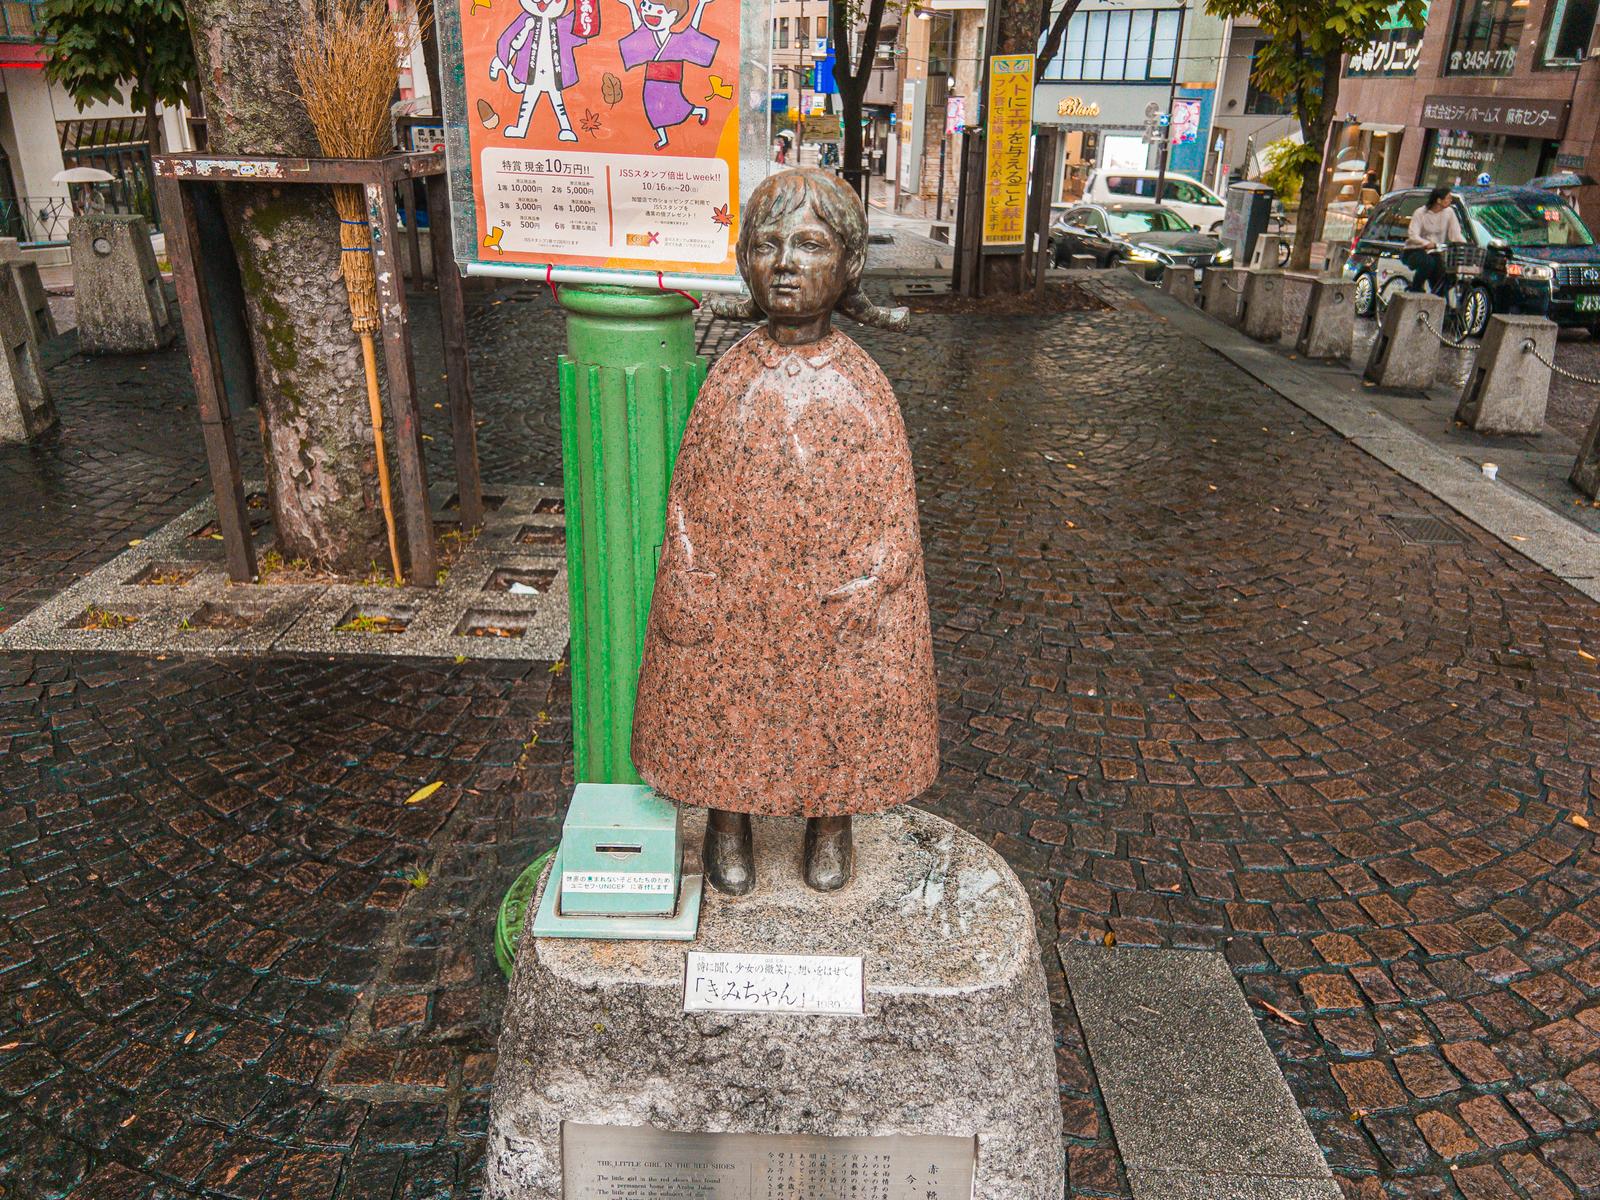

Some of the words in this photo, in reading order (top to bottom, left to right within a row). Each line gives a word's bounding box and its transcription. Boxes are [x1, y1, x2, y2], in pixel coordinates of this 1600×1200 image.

[1506, 108, 1556, 126] 麻布センター
[1001, 74, 1029, 232] ハトにエサを与えること禁止
[502, 160, 522, 172] 特賞
[511, 184, 543, 193] 10,000円
[566, 187, 594, 195] 5,000円
[515, 203, 542, 211] 3,000円
[569, 205, 596, 213] 1,000円
[520, 221, 540, 229] 500円
[696, 978, 805, 1008] 「きみちゃん」
